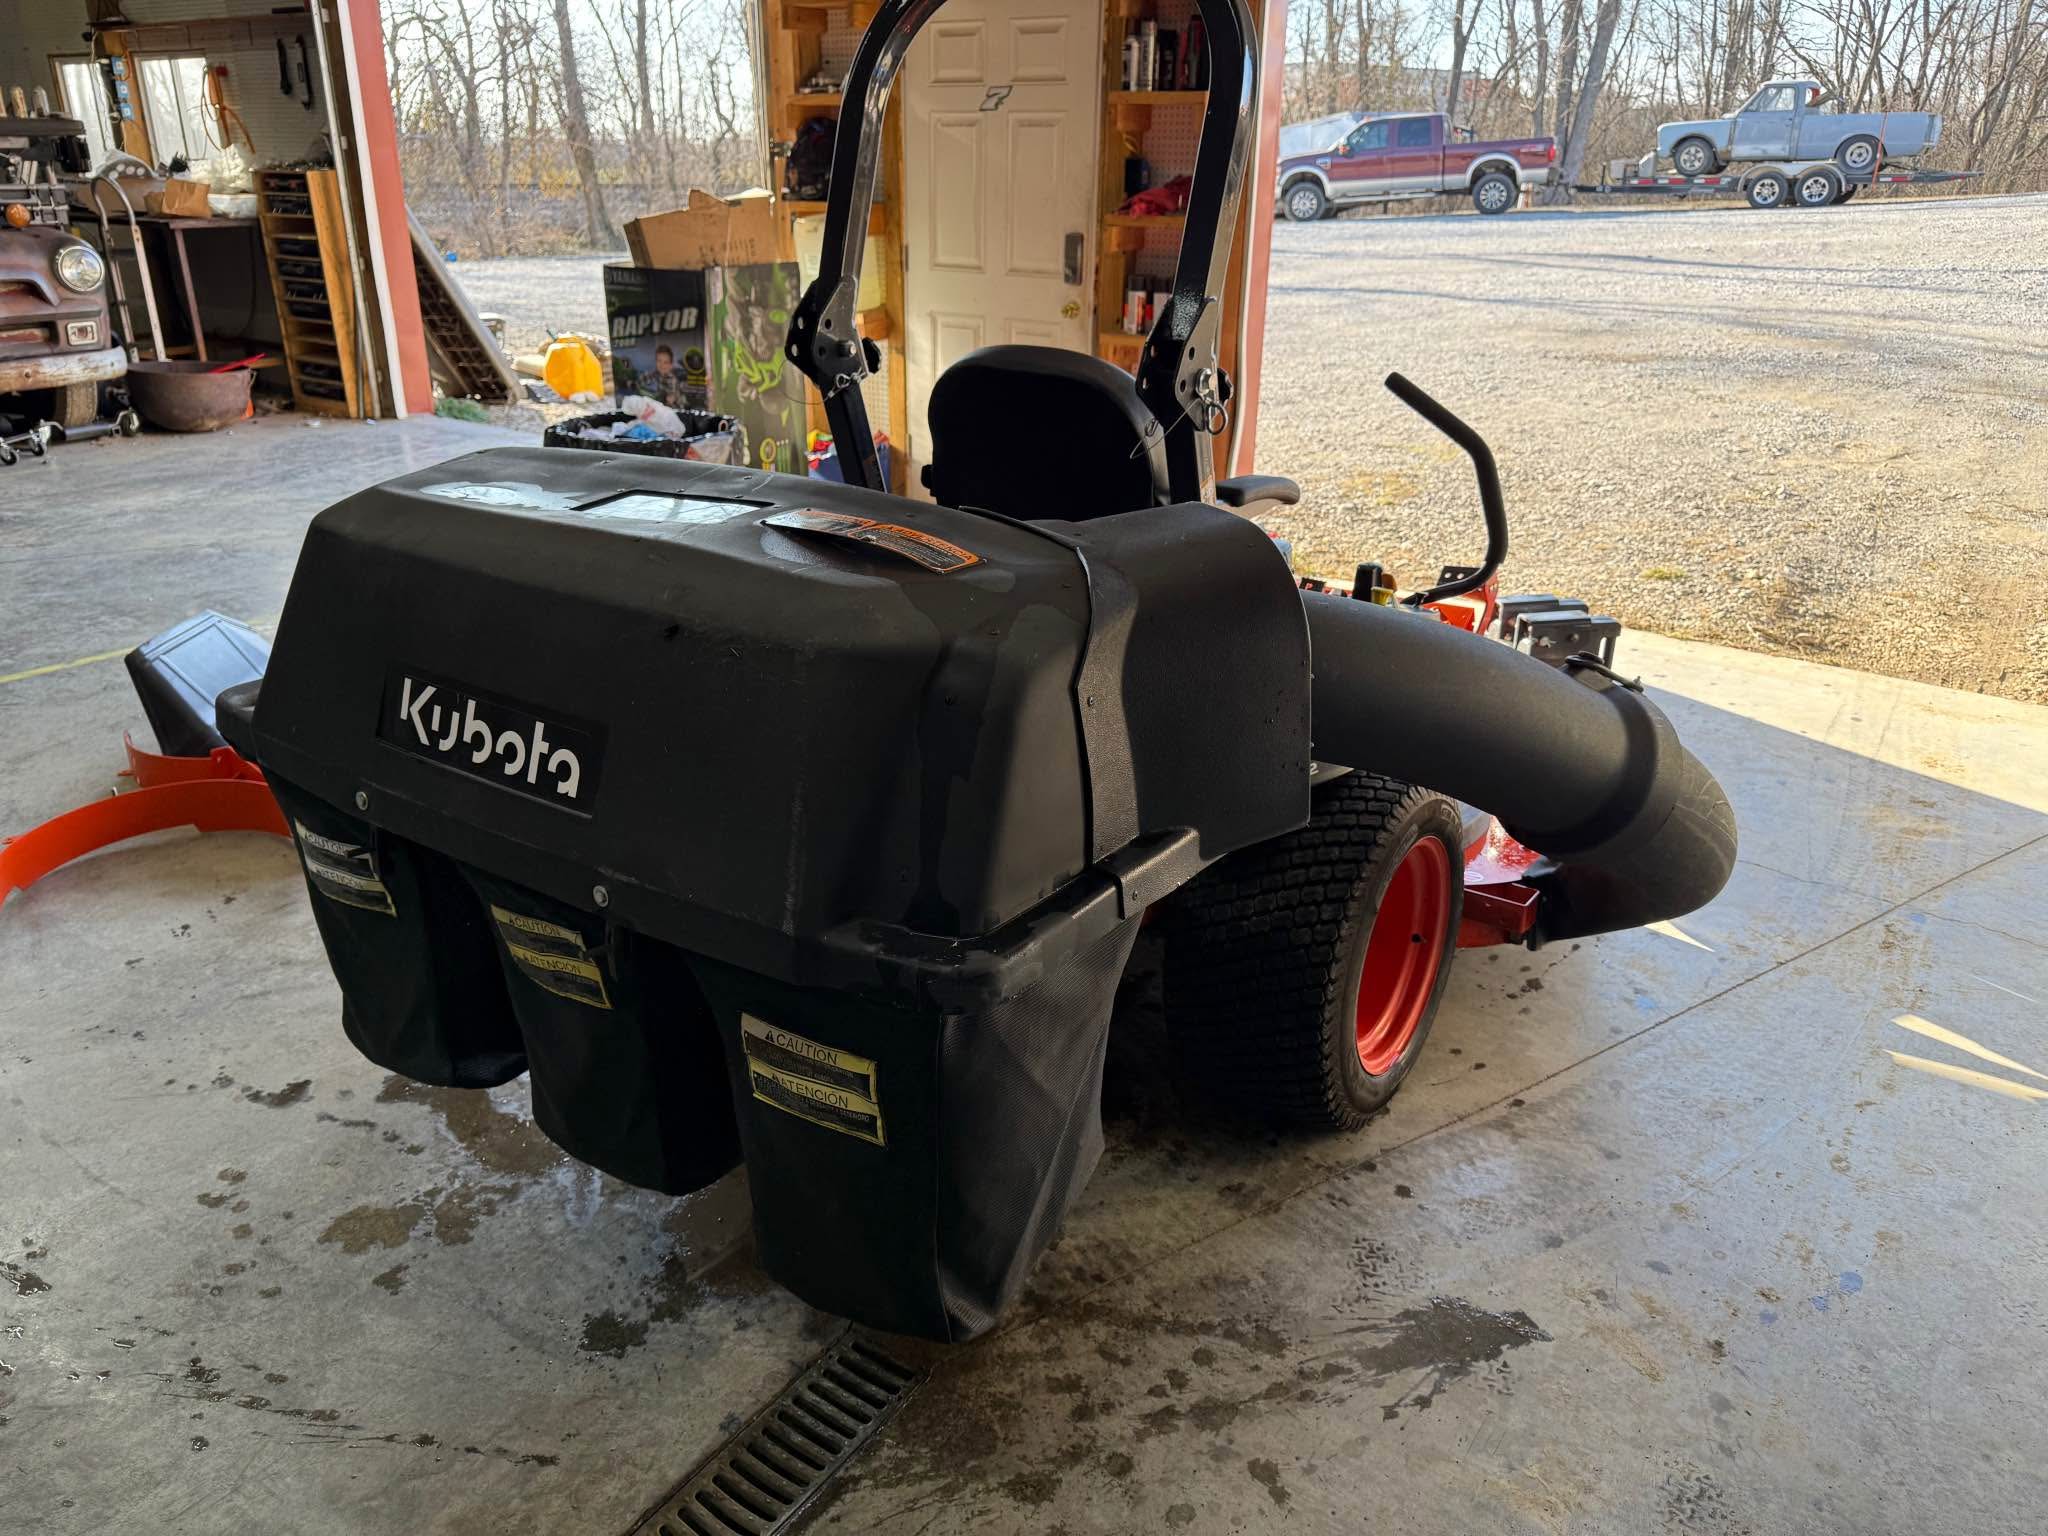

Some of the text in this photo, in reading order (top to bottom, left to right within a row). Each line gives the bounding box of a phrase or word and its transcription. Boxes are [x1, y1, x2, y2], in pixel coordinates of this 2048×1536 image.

[979, 85, 1013, 112] 7
[612, 306, 699, 338] RAPTOR
[400, 677, 580, 799] Kubota
[515, 916, 562, 937] CAUTION
[775, 1034, 838, 1065] CAUTION
[782, 1077, 848, 1108] ATENCION
